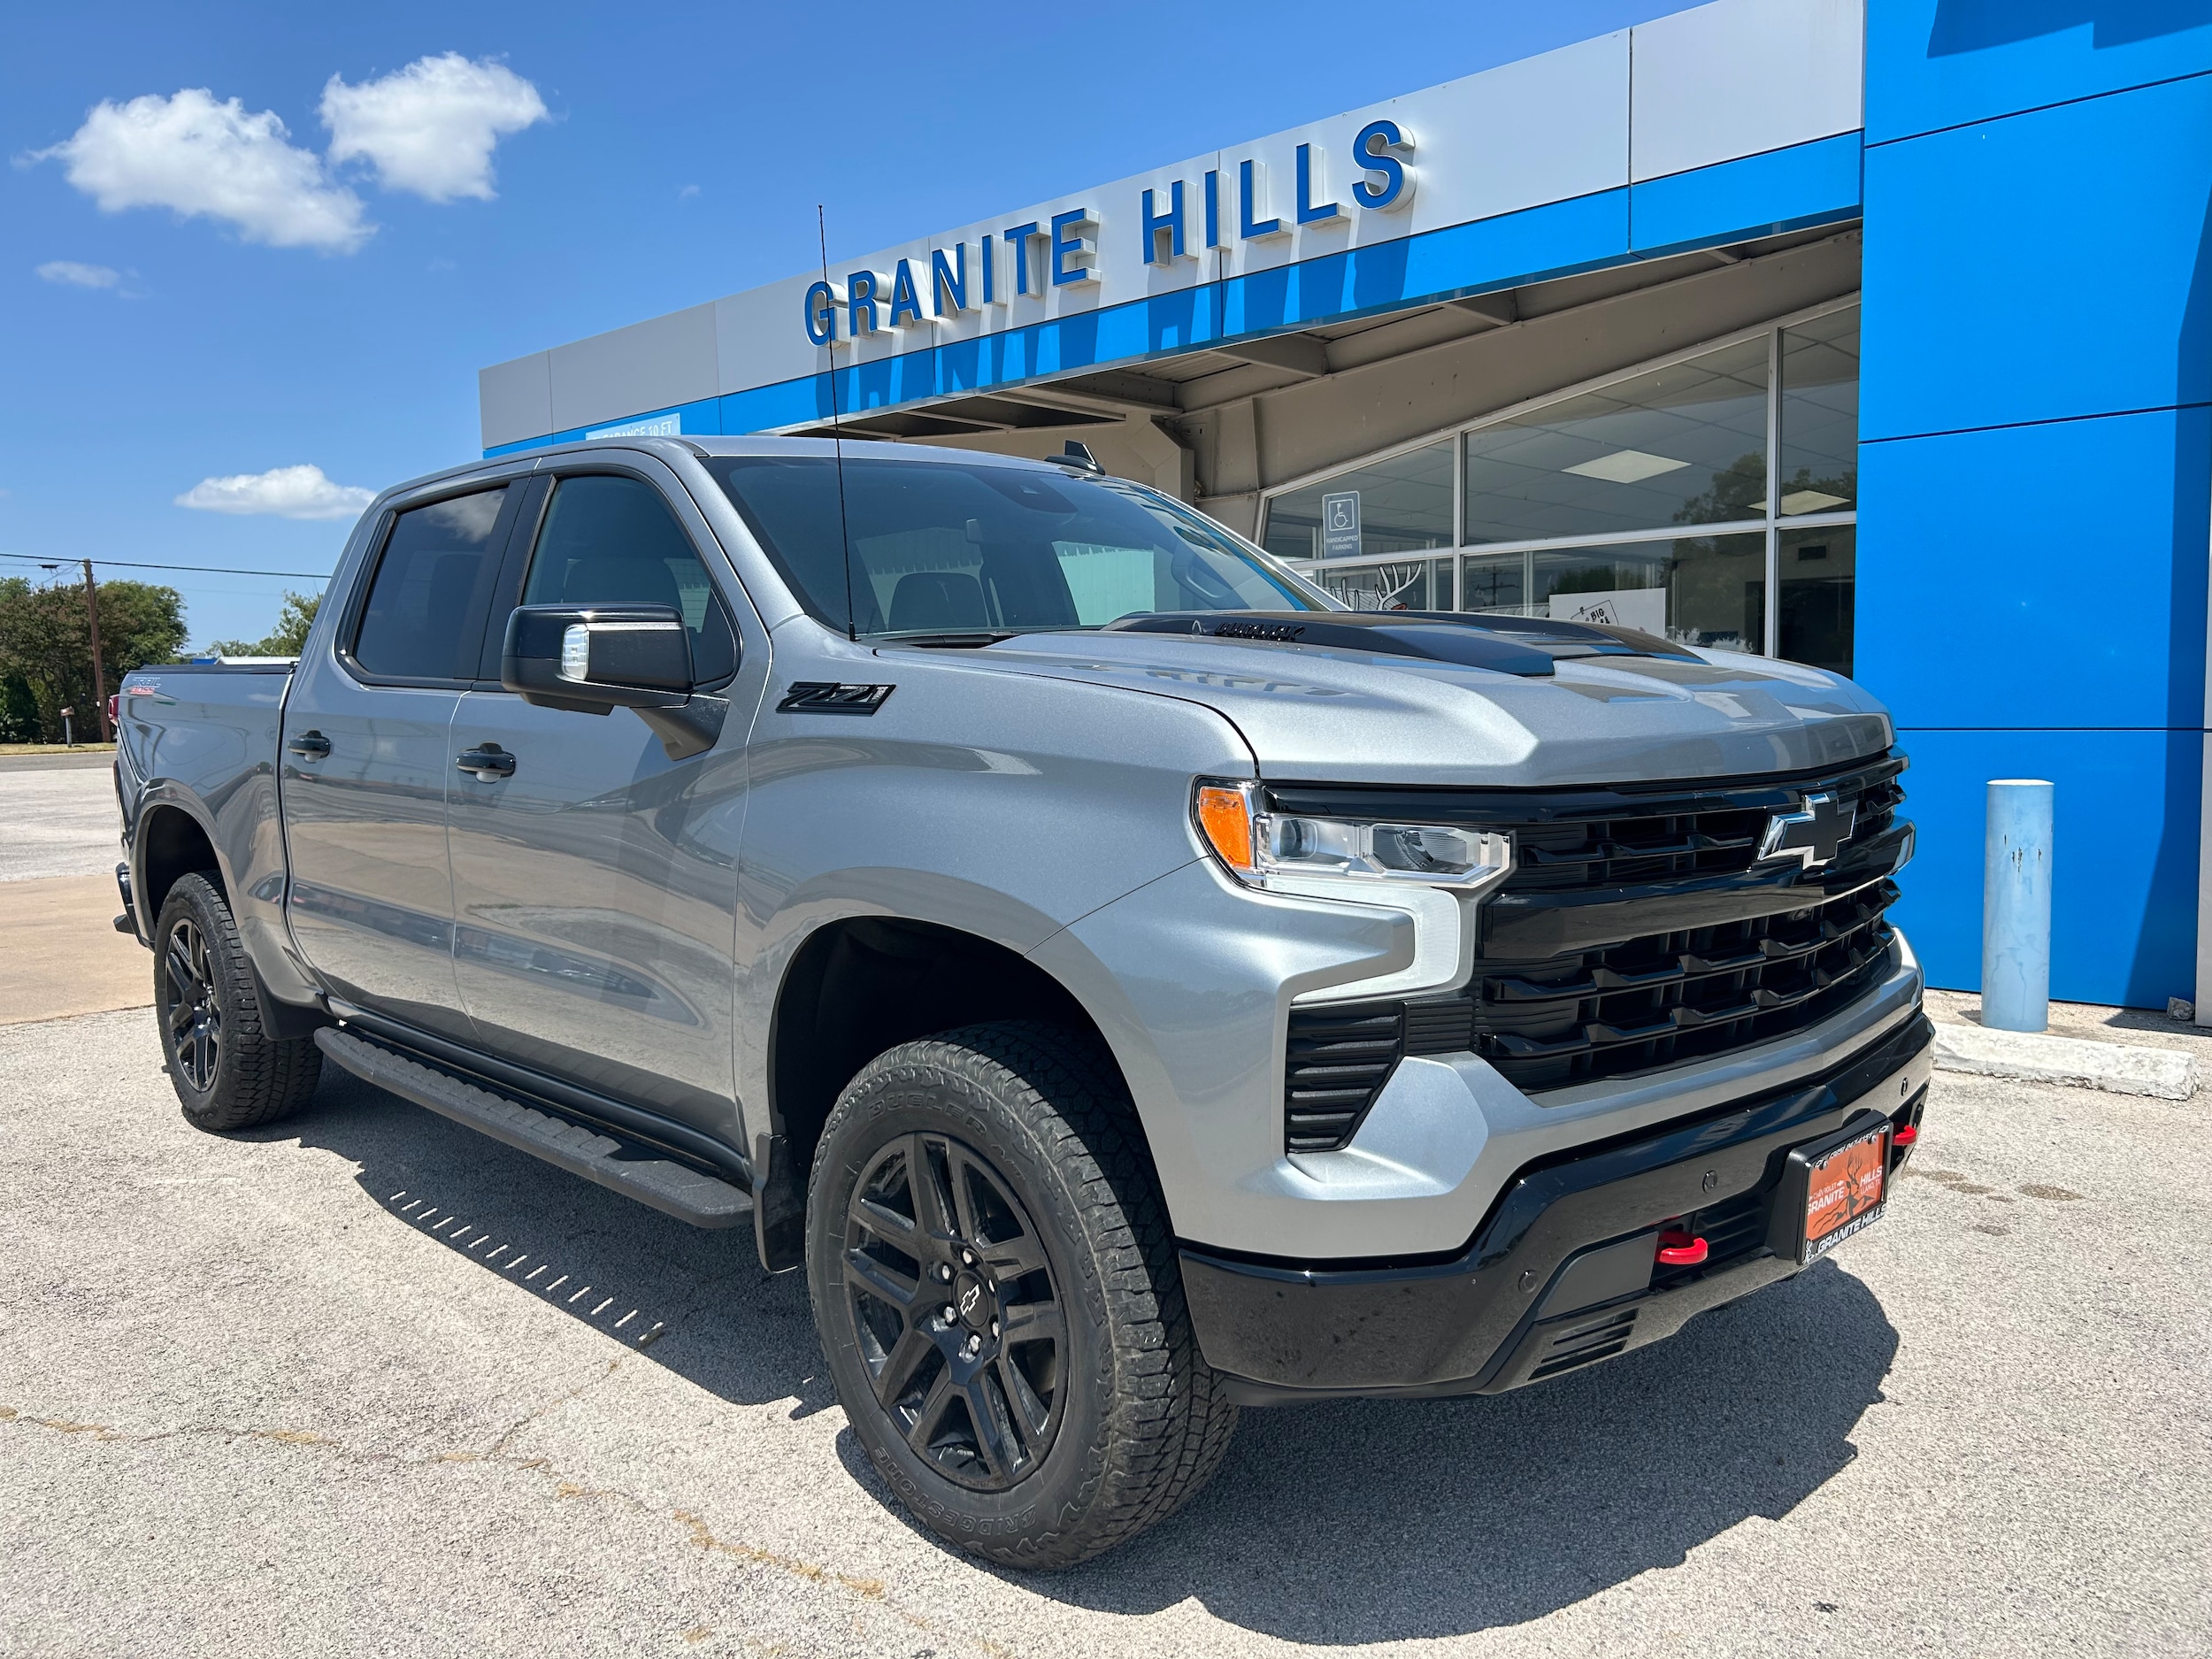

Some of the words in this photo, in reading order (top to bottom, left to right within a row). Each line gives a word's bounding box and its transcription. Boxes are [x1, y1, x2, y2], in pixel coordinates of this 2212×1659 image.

[804, 206, 1097, 347] GRANITE
[1141, 119, 1410, 266] HILLS
[661, 420, 672, 436] FT
[1326, 534, 1359, 544] HANDICAPPED
[1590, 608, 1605, 621] BIG
[133, 676, 162, 688] TRAIL
[775, 680, 897, 717] Z71
[867, 1091, 988, 1136] DUELER
[1807, 1186, 1845, 1217] GRANITE
[1860, 1165, 1883, 1188] HILLS
[1816, 1217, 1862, 1255] GRANITE
[1861, 1203, 1887, 1228] HILLS
[874, 1446, 1037, 1537] BRIDGESTONE
